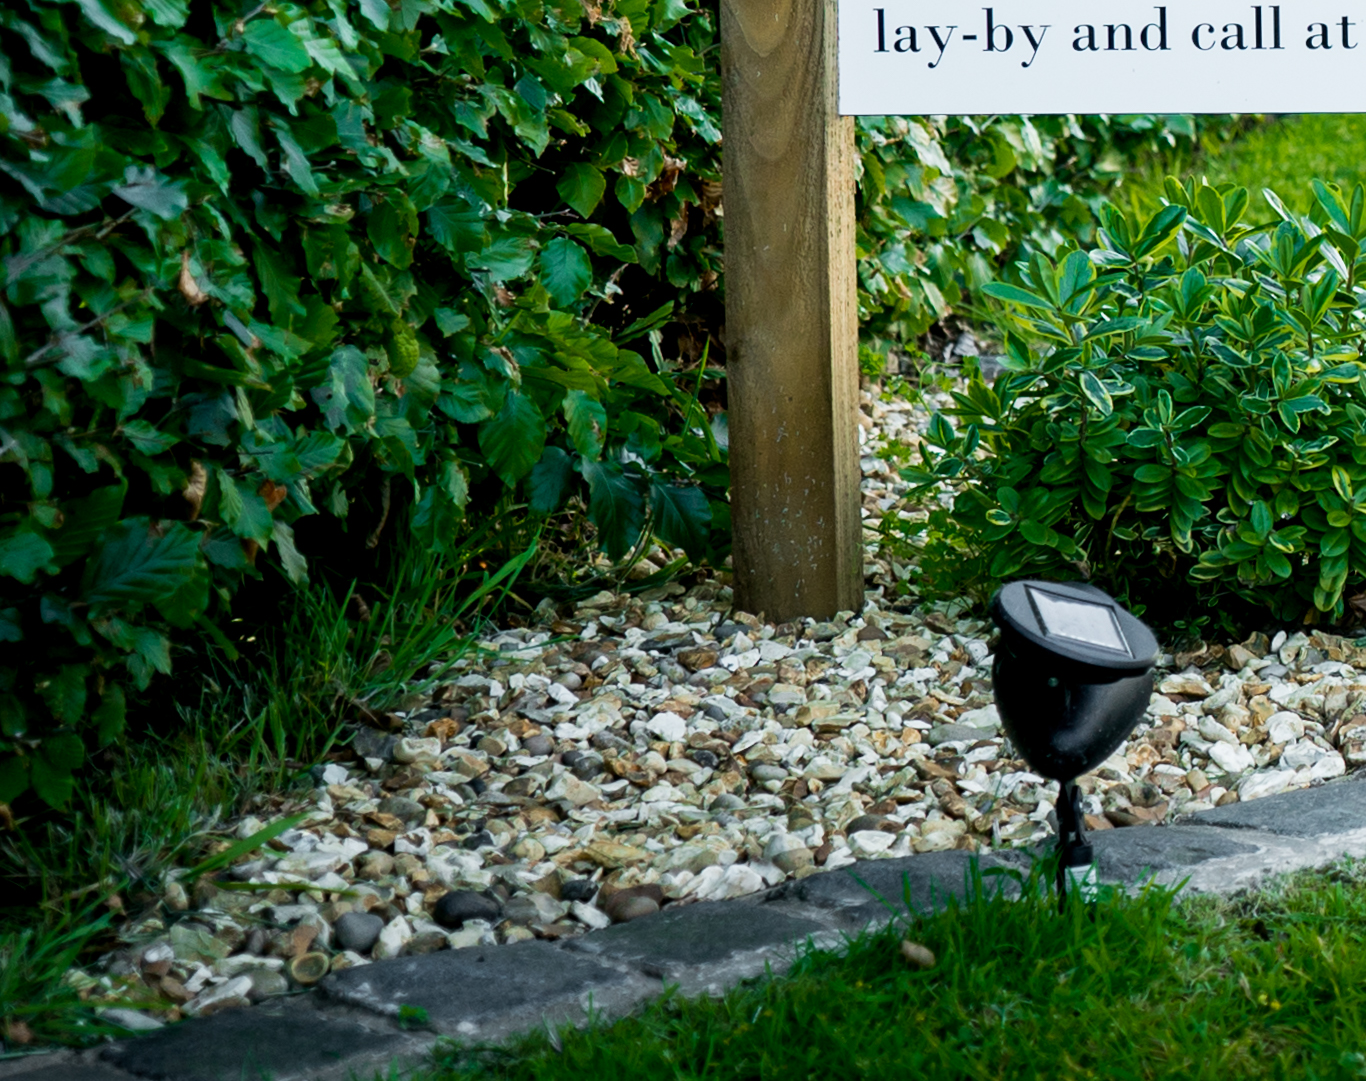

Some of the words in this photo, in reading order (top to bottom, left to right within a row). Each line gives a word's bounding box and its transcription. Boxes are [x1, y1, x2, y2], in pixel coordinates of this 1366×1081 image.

[872, 7, 1051, 69] lay-by
[1072, 6, 1171, 52] and
[1191, 5, 1285, 51] call
[1305, 13, 1358, 51] at
